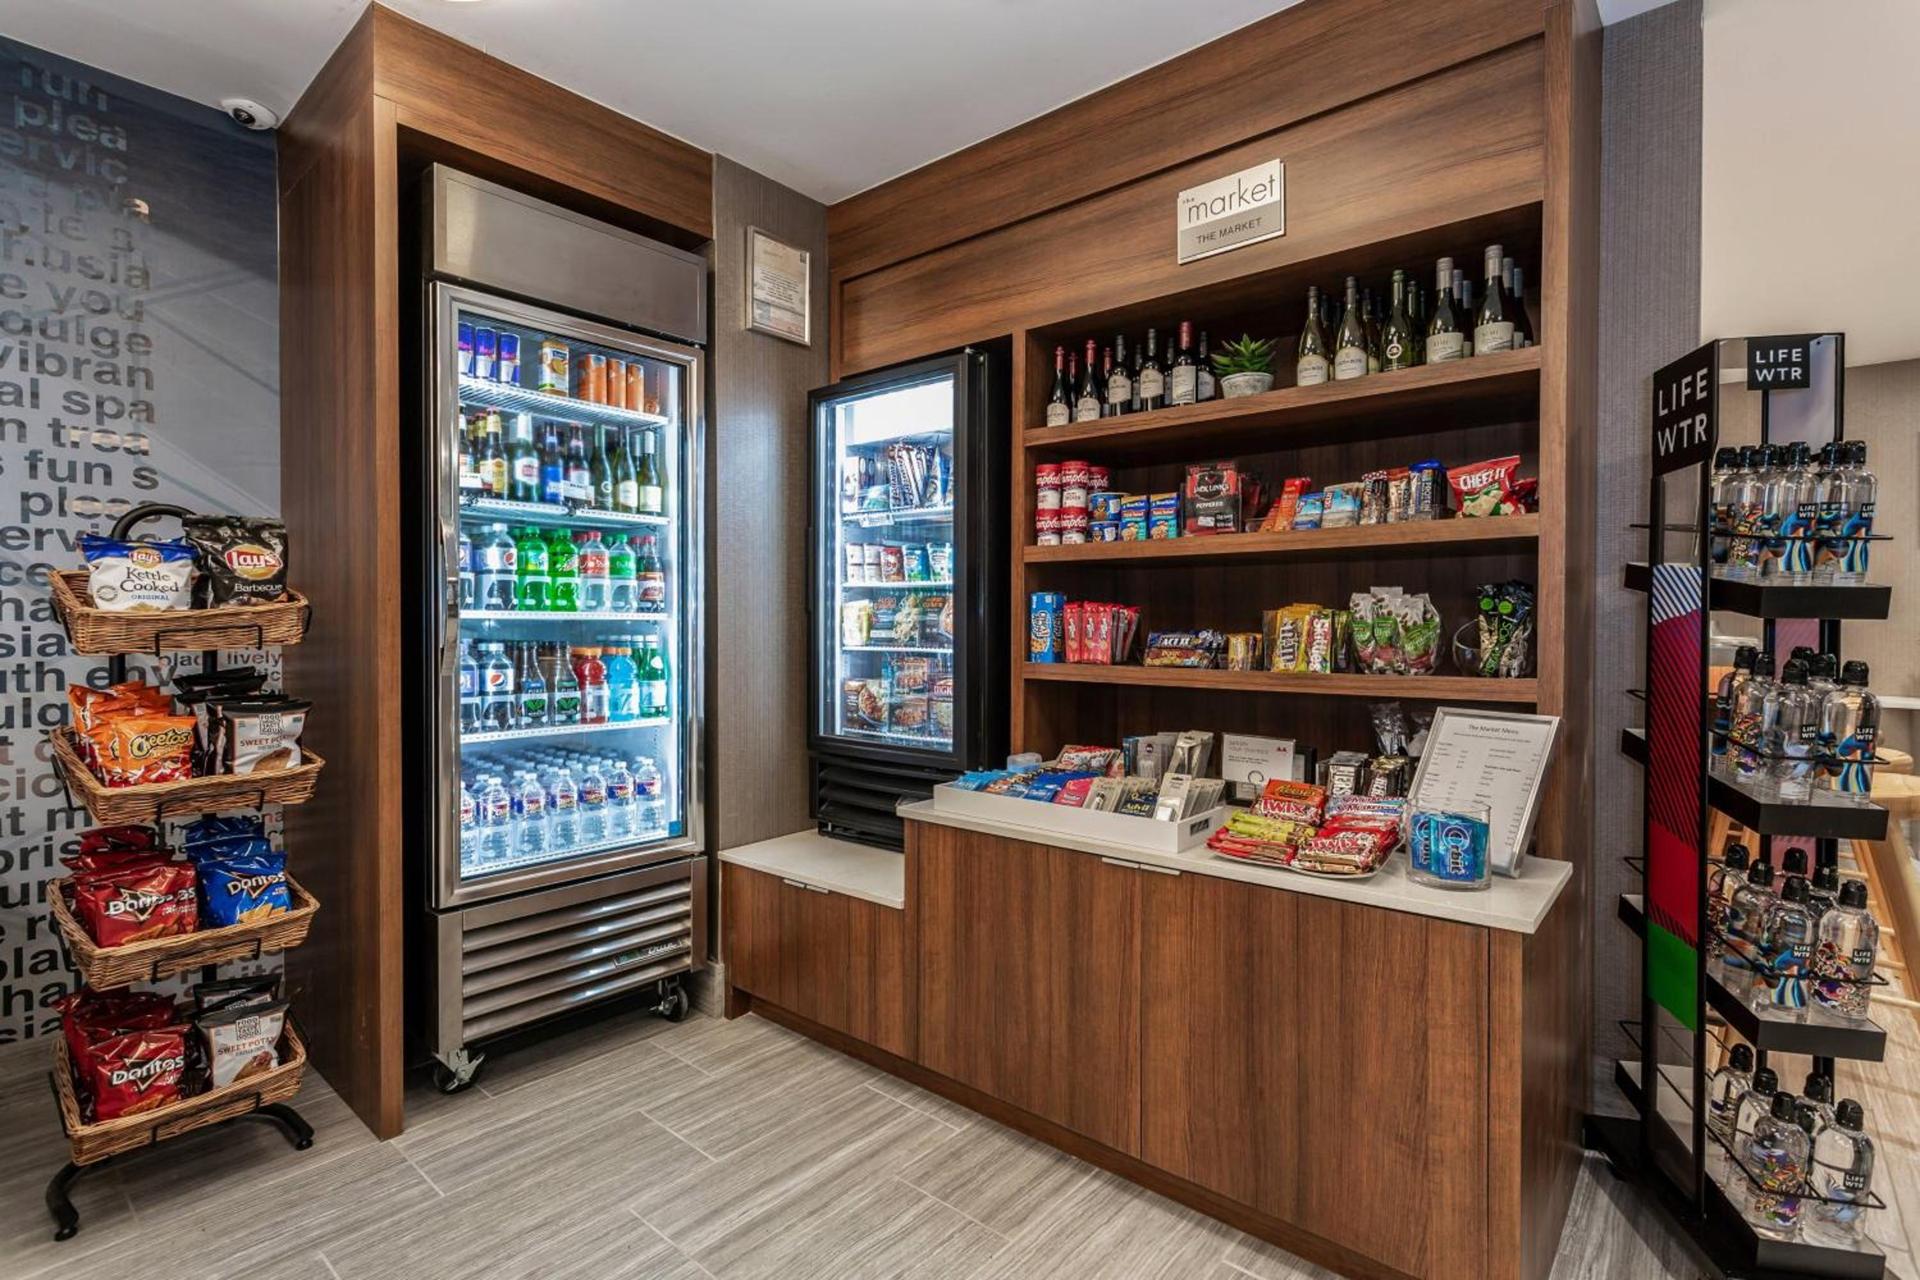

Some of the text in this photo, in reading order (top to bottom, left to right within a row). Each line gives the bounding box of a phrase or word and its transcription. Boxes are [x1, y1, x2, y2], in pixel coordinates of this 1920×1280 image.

[1188, 174, 1276, 223] market
[1196, 217, 1262, 244] THE MARKET
[1756, 348, 1802, 363] LIFE
[1755, 367, 1802, 382] WTR
[1658, 367, 1708, 416] LIFE
[62, 390, 155, 426] spa
[1658, 413, 1707, 456] WTR
[24, 448, 112, 486] fun
[119, 580, 179, 593] Cooked
[126, 567, 171, 581] Kettle
[234, 583, 283, 592] Barbecue
[227, 871, 286, 895] Doritos
[112, 1055, 185, 1086] Doritos
